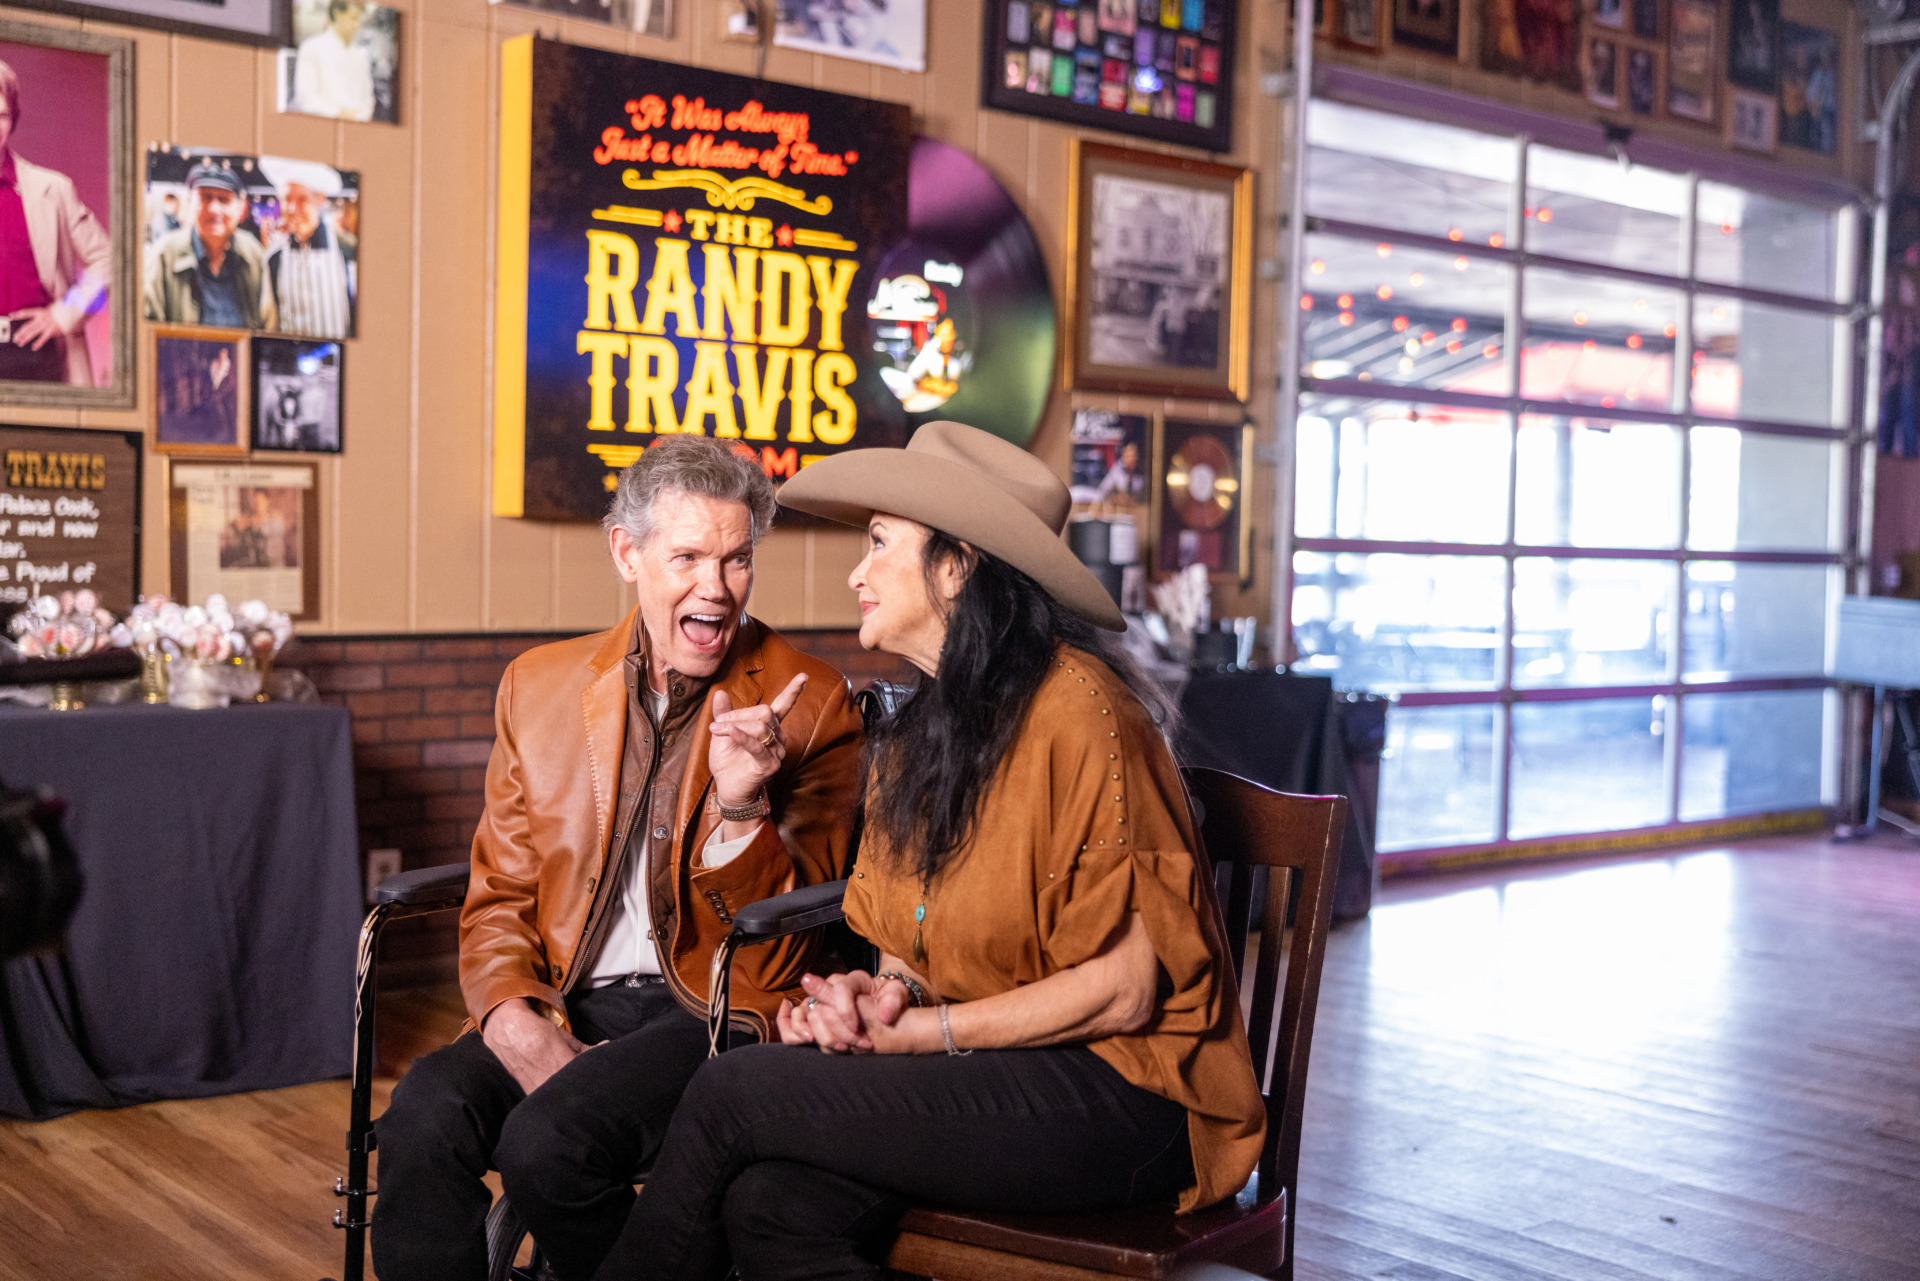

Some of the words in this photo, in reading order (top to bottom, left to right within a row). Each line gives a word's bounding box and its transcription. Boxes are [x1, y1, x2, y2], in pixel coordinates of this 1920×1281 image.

[671, 94, 723, 131] Was
[724, 100, 809, 145] Always
[593, 126, 652, 165] Just
[650, 141, 671, 164] a
[672, 133, 759, 169] Matter
[758, 143, 789, 178] of
[685, 209, 774, 249] THE
[583, 229, 859, 351] RANDY
[577, 330, 857, 445] TRAVIS
[7, 451, 105, 489] TRAVIS
[17, 517, 55, 537] and
[62, 521, 99, 538] now
[16, 561, 69, 583] Proud
[72, 562, 97, 583] of
